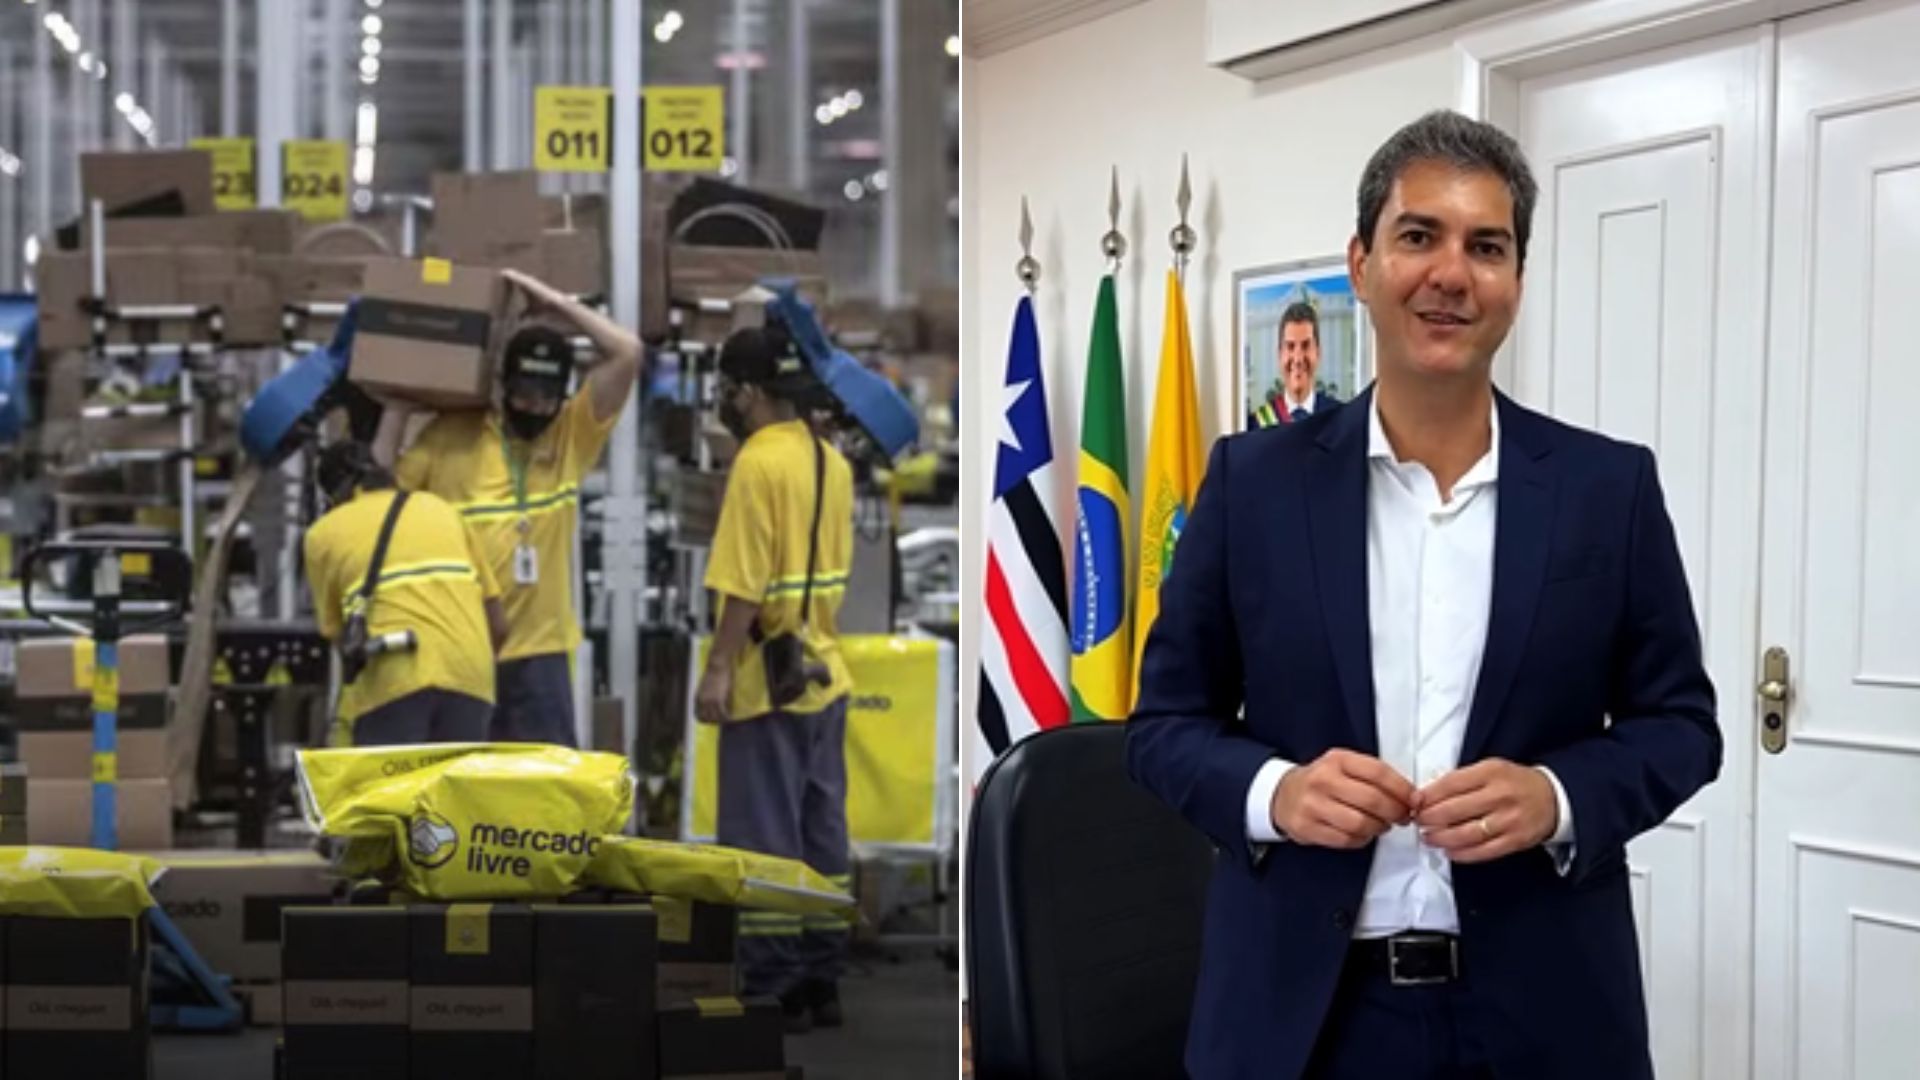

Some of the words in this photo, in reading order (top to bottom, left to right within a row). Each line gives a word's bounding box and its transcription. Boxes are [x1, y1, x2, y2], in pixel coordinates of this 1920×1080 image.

[547, 129, 599, 158] 011
[650, 128, 713, 158] 012
[213, 171, 250, 195] 23
[283, 172, 341, 198] 024
[471, 823, 602, 858] mercado
[467, 846, 531, 877] livre
[161, 897, 222, 919] cado
